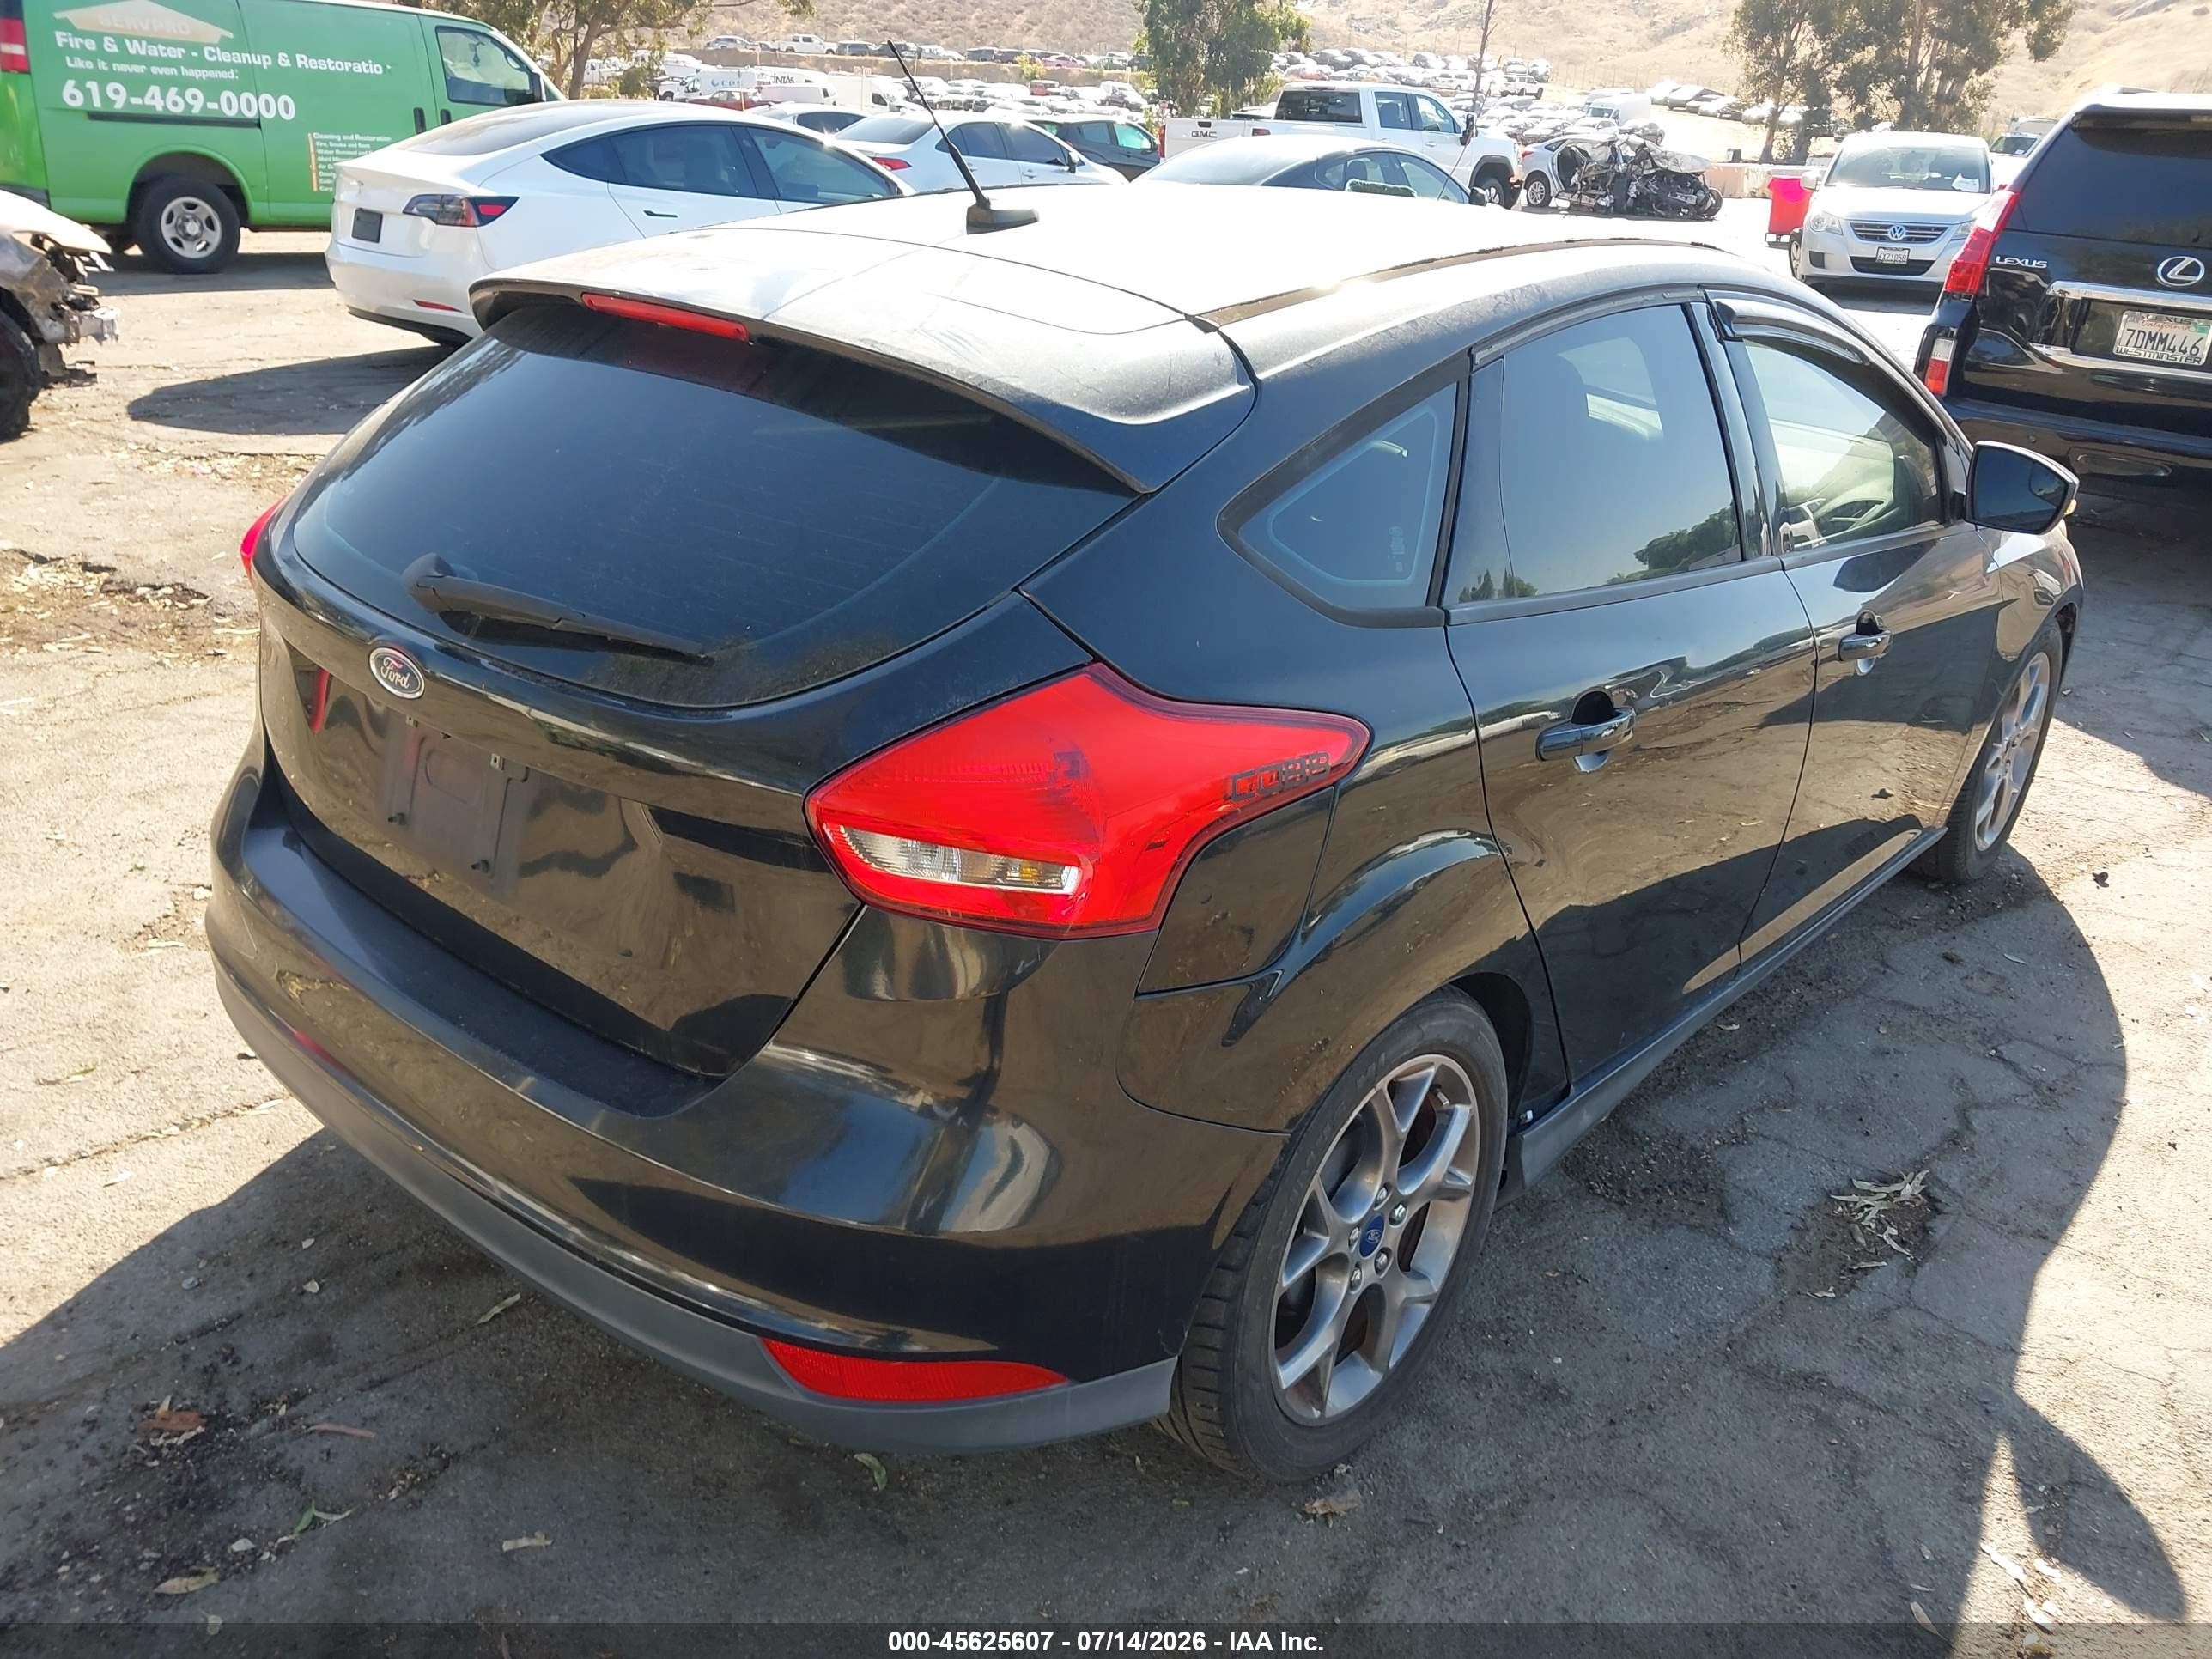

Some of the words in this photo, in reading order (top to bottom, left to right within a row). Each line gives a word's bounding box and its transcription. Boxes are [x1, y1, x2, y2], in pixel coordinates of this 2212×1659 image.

[55, 31, 96, 51] Fire
[103, 36, 118, 52] &
[125, 39, 185, 58] Water
[204, 46, 272, 69] Cleanup
[277, 52, 291, 67] &
[295, 53, 392, 75] Restoratio
[65, 57, 94, 69] Like
[97, 59, 108, 70] it
[112, 63, 146, 73] never
[150, 65, 178, 76] even
[62, 79, 296, 120] 619-469-0000
[313, 132, 341, 141] Cleaning
[1996, 256, 2048, 269] LEXUS
[2116, 346, 2203, 365] WESTMINSTER
[2125, 328, 2204, 356] 7DMM446
[380, 656, 410, 689] Ford
[1231, 752, 1331, 802] COBB
